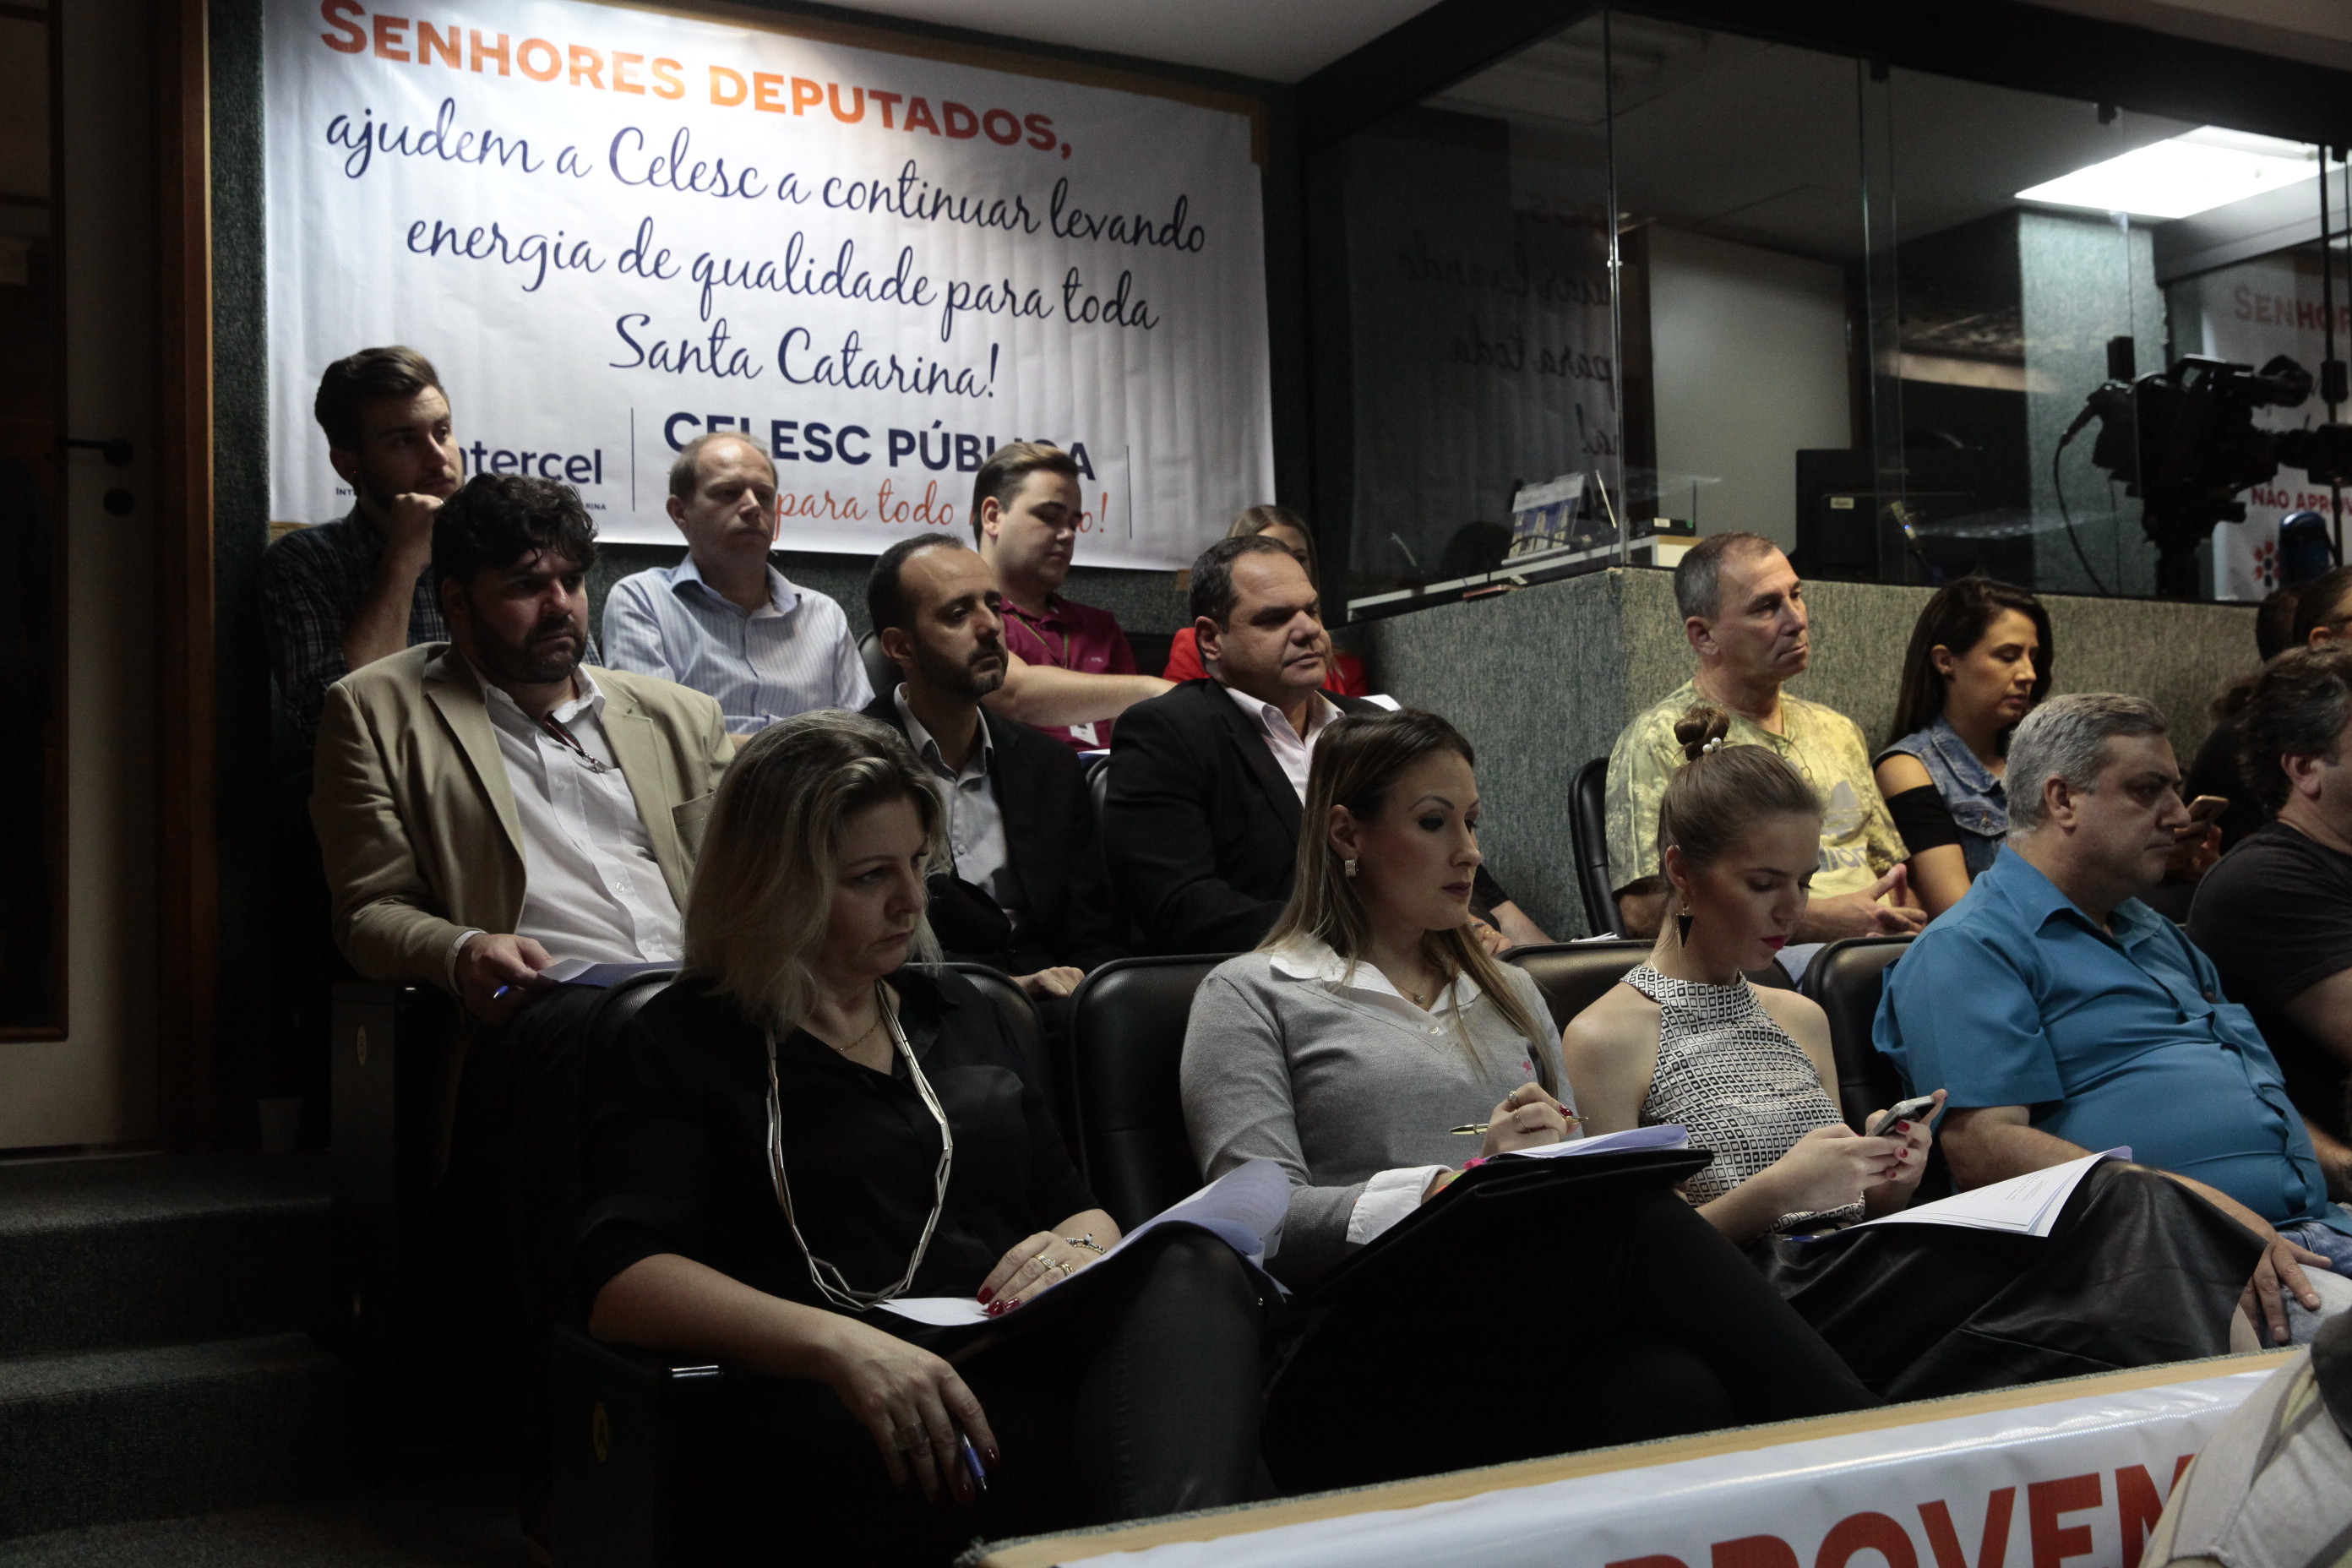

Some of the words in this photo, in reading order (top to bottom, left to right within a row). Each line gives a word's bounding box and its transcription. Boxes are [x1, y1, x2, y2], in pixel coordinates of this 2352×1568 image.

[320, 0, 685, 100] SENHORES
[708, 65, 1073, 159] DEPUTADOS,
[326, 97, 543, 178] ajudem
[556, 144, 592, 178] a
[608, 127, 768, 199] Celesc
[777, 172, 812, 204] a
[822, 159, 1042, 234] continuar
[1050, 177, 1206, 253] levando
[406, 219, 606, 291] energia
[618, 216, 681, 280] de
[691, 231, 938, 322] qualidade
[941, 277, 1055, 341] para
[1062, 266, 1161, 329] toda
[609, 313, 763, 378] Santa
[777, 327, 999, 399] Catarina!
[771, 489, 868, 542] para
[878, 478, 954, 525] todo
